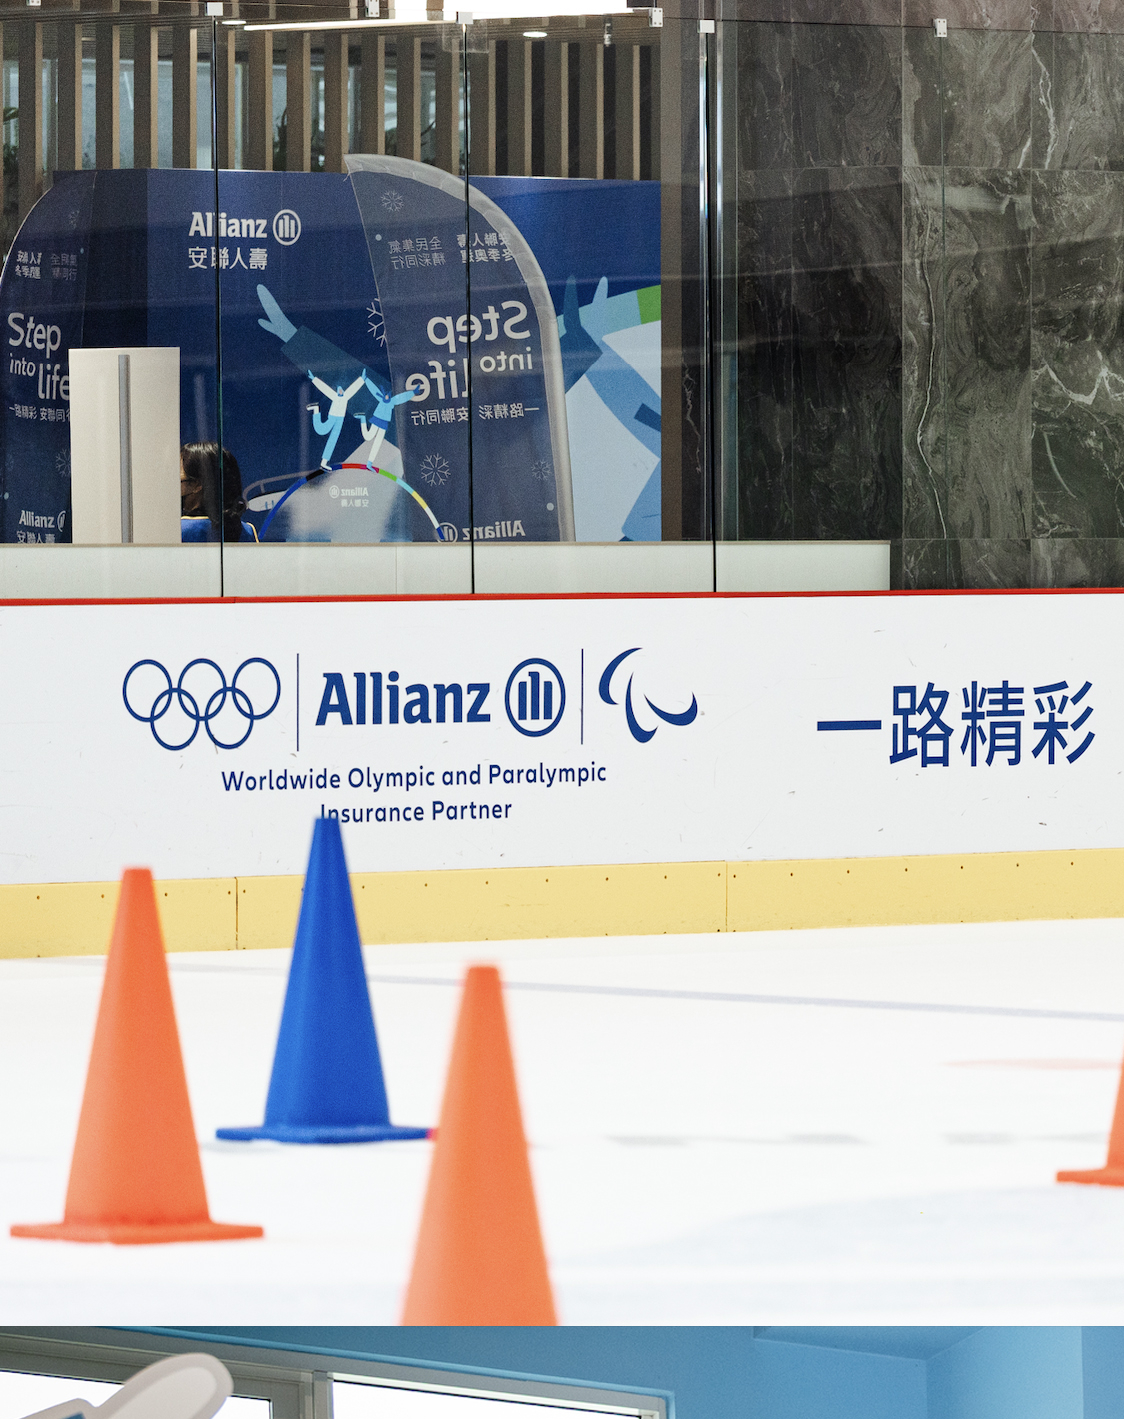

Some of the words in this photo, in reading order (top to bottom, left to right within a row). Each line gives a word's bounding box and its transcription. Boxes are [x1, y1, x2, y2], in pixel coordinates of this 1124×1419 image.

[188, 211, 268, 238] Alianz
[188, 246, 268, 270] 安聯人壽
[8, 312, 62, 359] Step
[9, 353, 36, 377] into
[38, 363, 70, 401] life
[19, 510, 55, 528] Allianz
[315, 670, 491, 726] Allianz
[816, 680, 1097, 768] 一路精彩
[221, 767, 341, 794] Worldwide
[348, 764, 435, 792] Olympic
[442, 764, 482, 786] and
[489, 761, 607, 787] Paralympic
[432, 800, 512, 821] Partner
